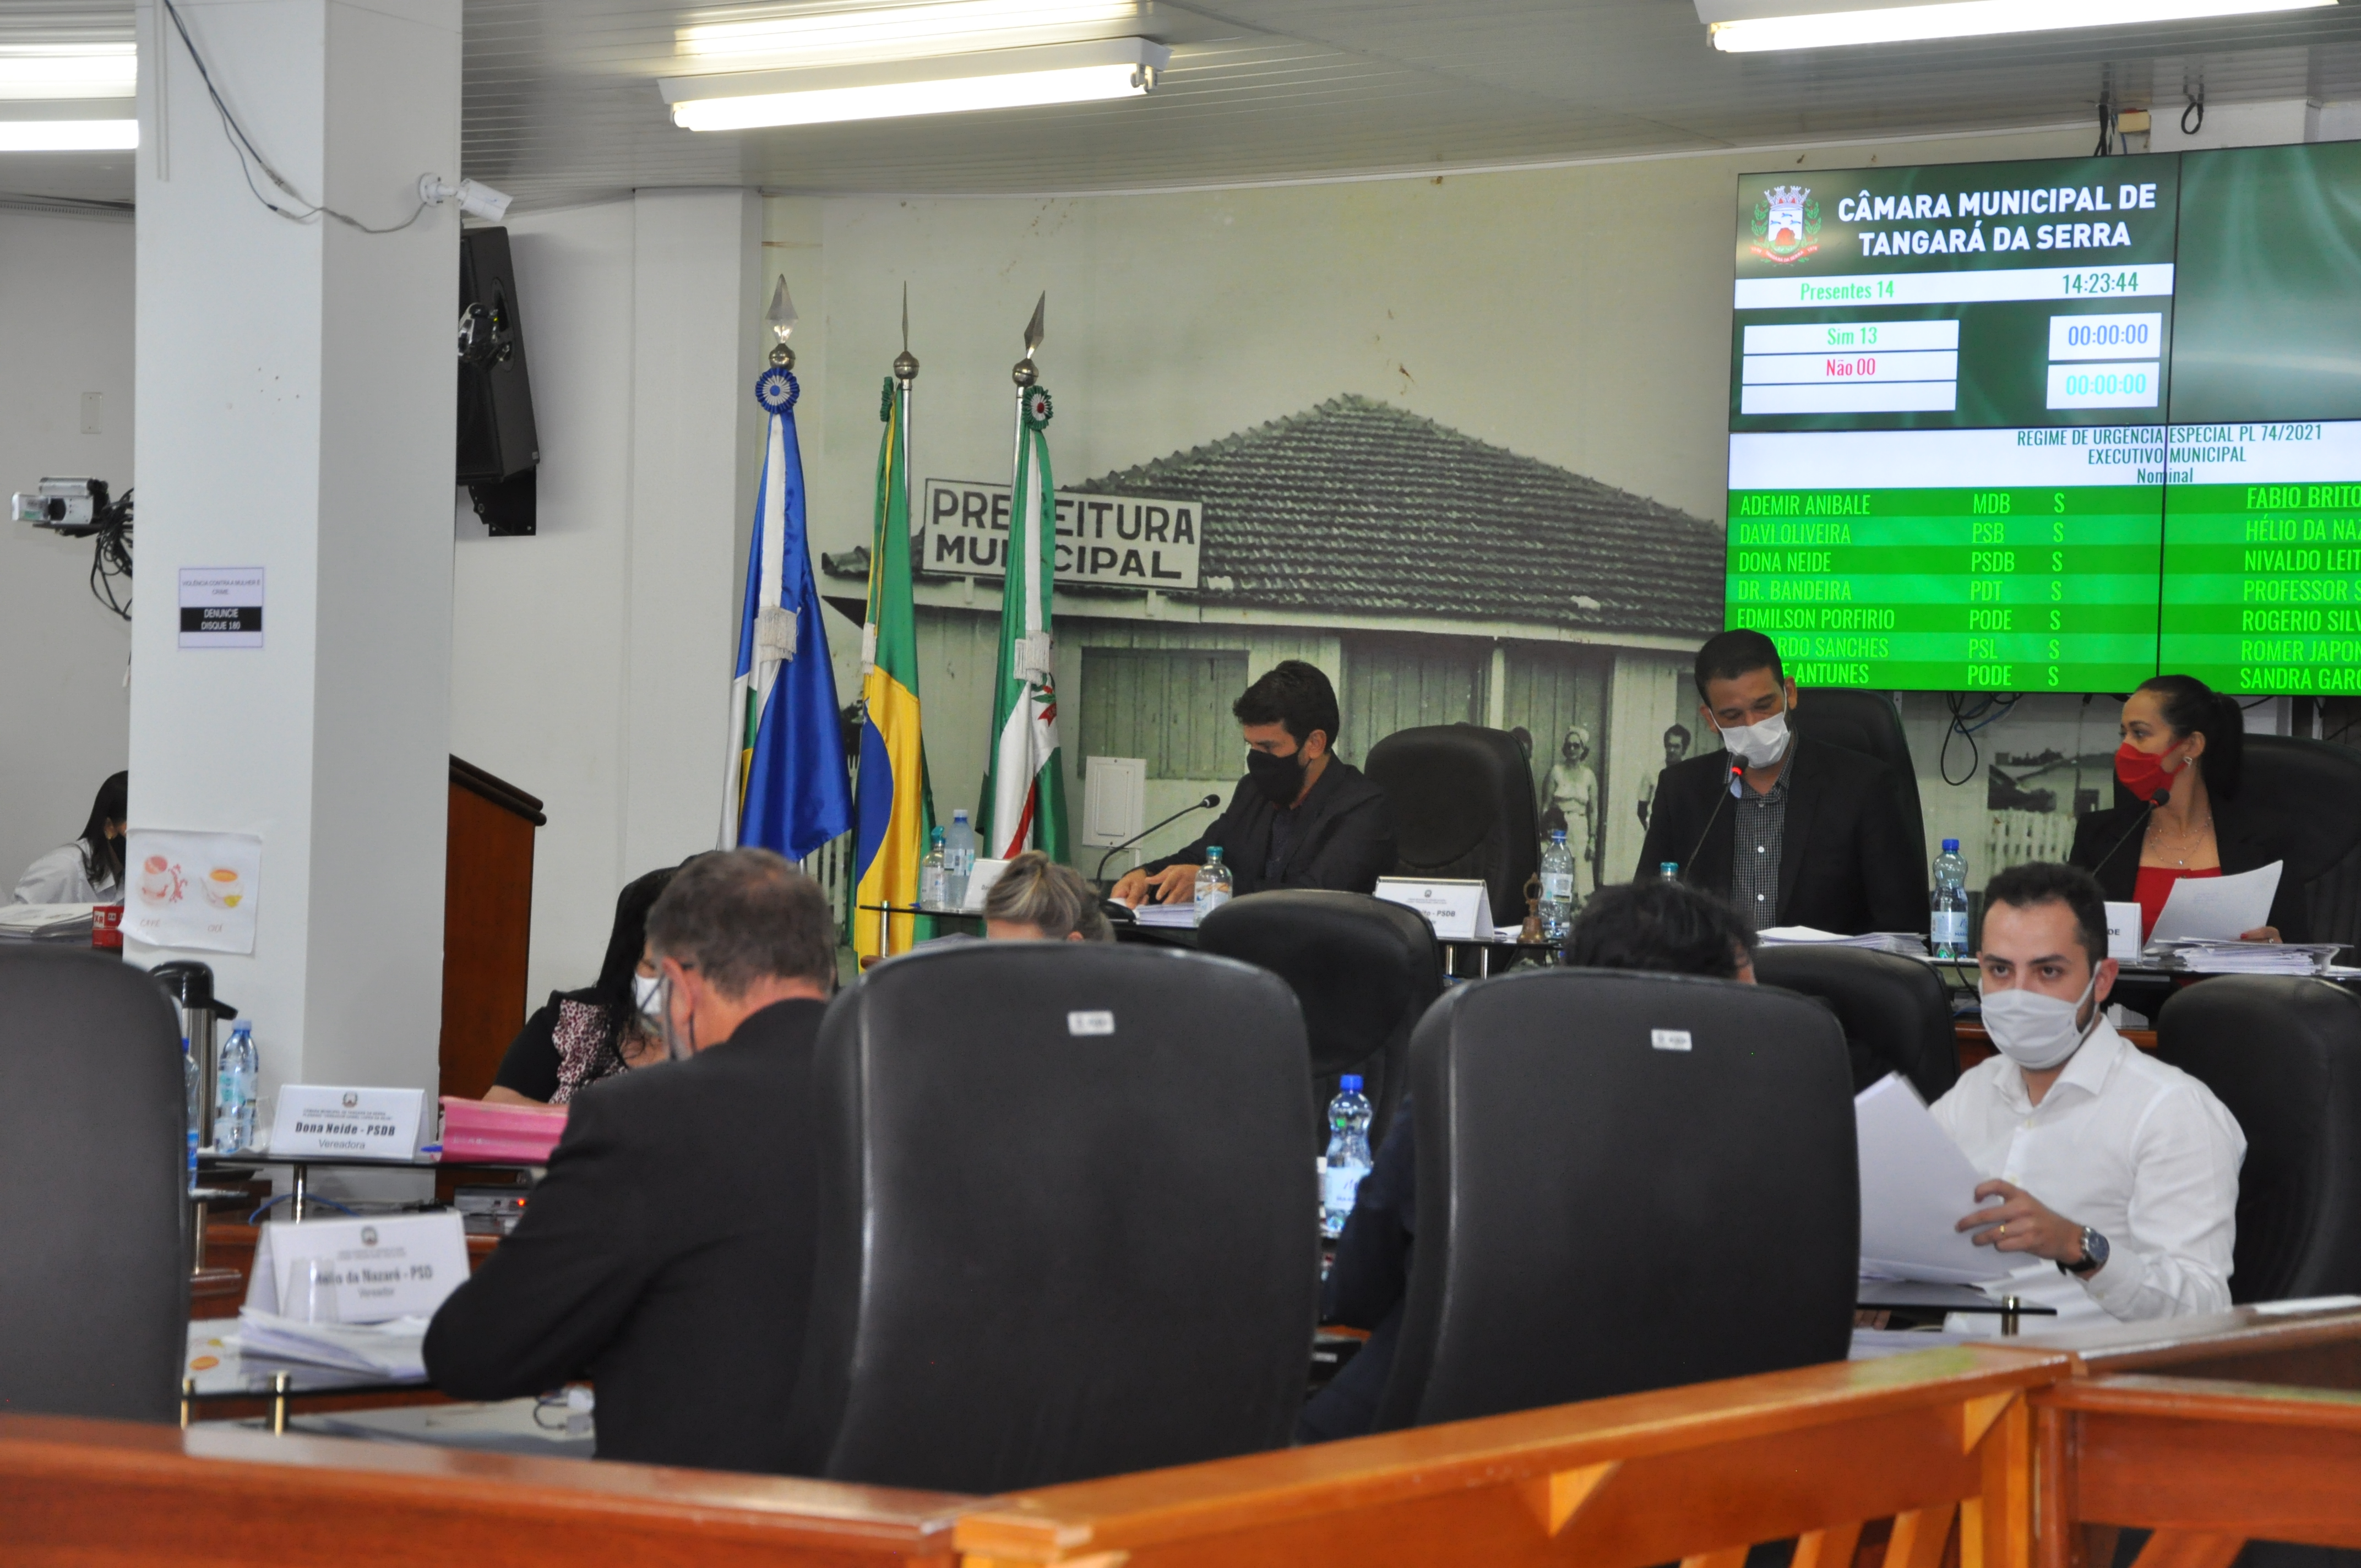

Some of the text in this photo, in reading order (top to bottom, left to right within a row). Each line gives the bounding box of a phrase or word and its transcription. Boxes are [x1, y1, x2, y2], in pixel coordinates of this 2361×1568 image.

[1838, 183, 2156, 221] CÂMARA MUNICIPAL DE
[1859, 220, 2131, 256] TANGARÁ DA SERRA
[1800, 280, 1894, 301] Presentes 14
[2063, 272, 2139, 295] 14:23:44
[1827, 326, 1878, 345] Sim 13
[2069, 324, 2148, 345] 00:00:00
[1826, 358, 1875, 376] Não 00
[2066, 374, 2146, 395] 00:00:00
[2017, 423, 2321, 446] REGIME DE URGÊNCIA ESPECIAL PL 74/2021
[2088, 446, 2246, 464] EXECUTIVO MUNICIPAL
[2137, 467, 2193, 483] Nominal
[1740, 492, 2065, 515] ADEMIR ANIBALE MDB S
[2247, 486, 2361, 508] FABIO BRITO
[933, 488, 1195, 545] PREEITURA
[2246, 513, 2297, 541] HÉLIO
[2304, 519, 2326, 540] DA
[1740, 522, 2064, 544] DAVI OLIVEIRA PSB S
[936, 534, 1182, 579] MUCIPAL
[1739, 551, 2063, 572] DONA NEIDE PSDB S
[2245, 549, 2320, 571] NIVALDO
[1738, 580, 2061, 601] DR. BANDEIRA PDT S
[2244, 580, 2348, 601] PROFESSOR
[204, 608, 238, 618] DENUNCIE
[1737, 608, 2060, 630] EDMILSON PORFIRIO PODE S
[2243, 610, 2321, 631] ROGERIO
[201, 622, 227, 630] DISQUE
[1815, 637, 1889, 658] SANCHES
[1969, 638, 1998, 658] PSL
[2049, 639, 2060, 660] S
[2242, 640, 2304, 661] ROMER
[1795, 663, 1869, 683] ANTUNES
[1968, 665, 2012, 685] PODE
[2048, 666, 2059, 686] S
[2240, 668, 2312, 689] SANDRA
[295, 1122, 323, 1134] Dona
[325, 1123, 357, 1135] Neide
[366, 1125, 395, 1136] PSDB
[319, 1139, 365, 1150] Vereadora
